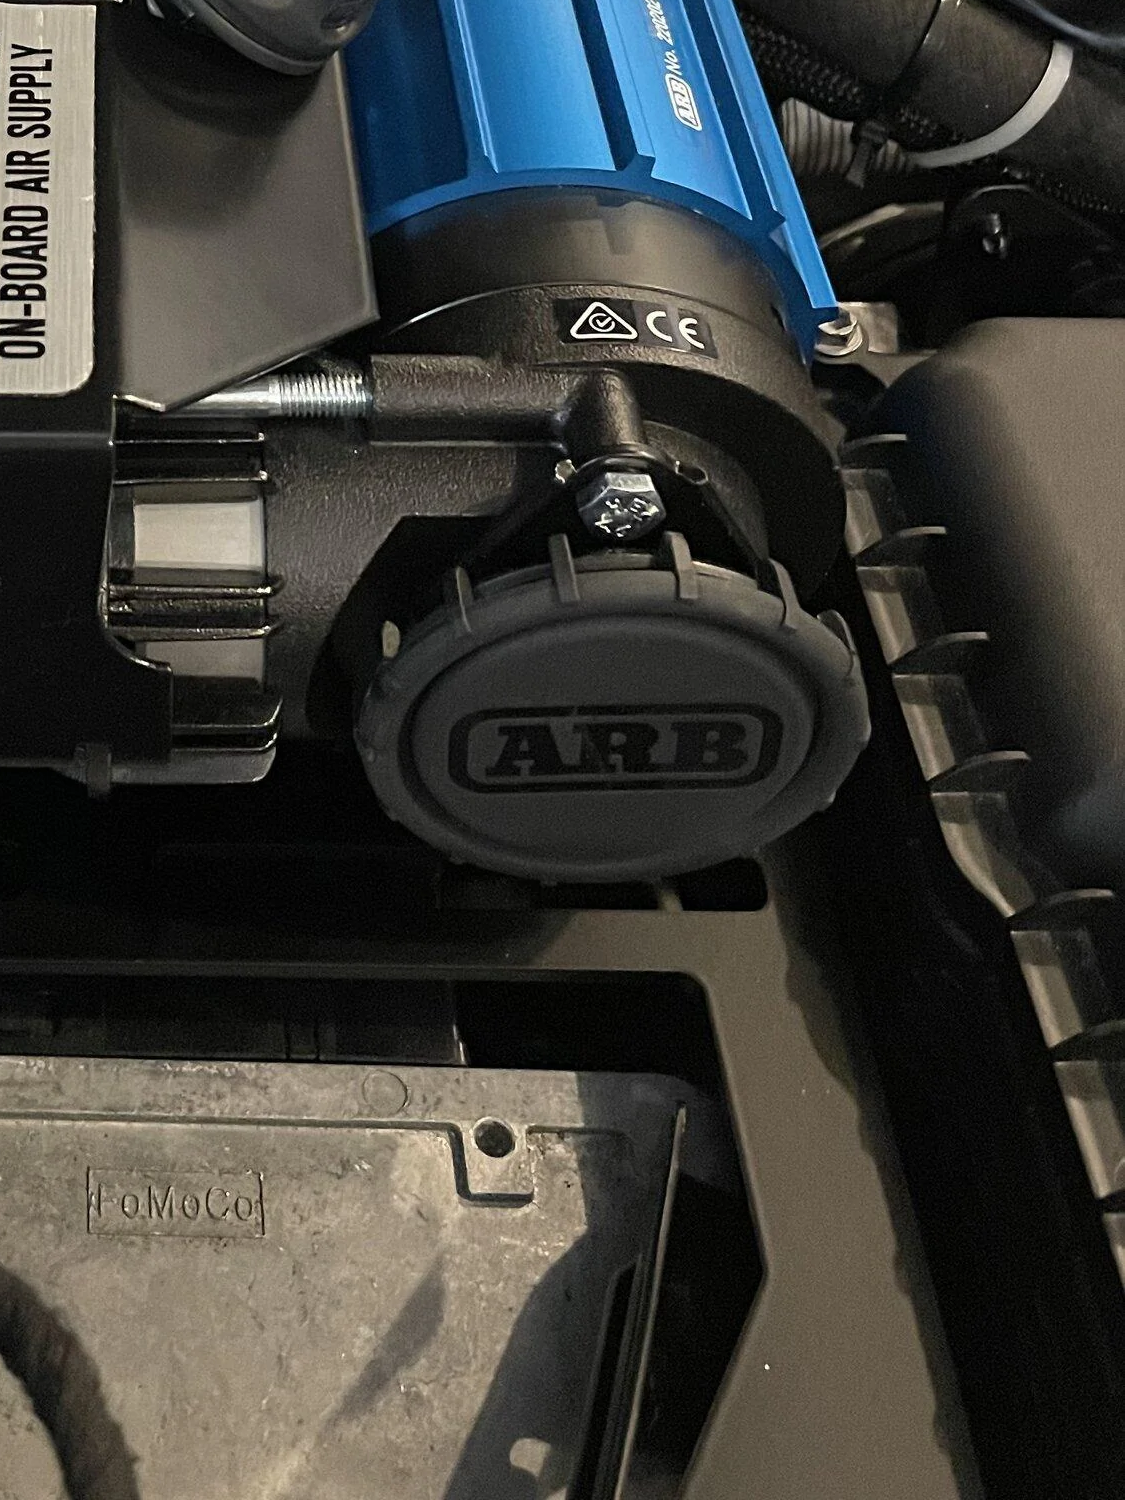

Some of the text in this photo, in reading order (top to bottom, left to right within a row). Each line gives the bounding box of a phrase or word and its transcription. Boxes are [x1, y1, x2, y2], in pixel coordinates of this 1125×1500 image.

[664, 50, 682, 76] No.
[6, 43, 53, 139] SUPPLY
[671, 77, 699, 128] ARB
[5, 149, 50, 194] AIR
[646, 310, 705, 350] CE
[485, 721, 749, 778] ARB
[97, 1182, 253, 1222] FoMoCo
